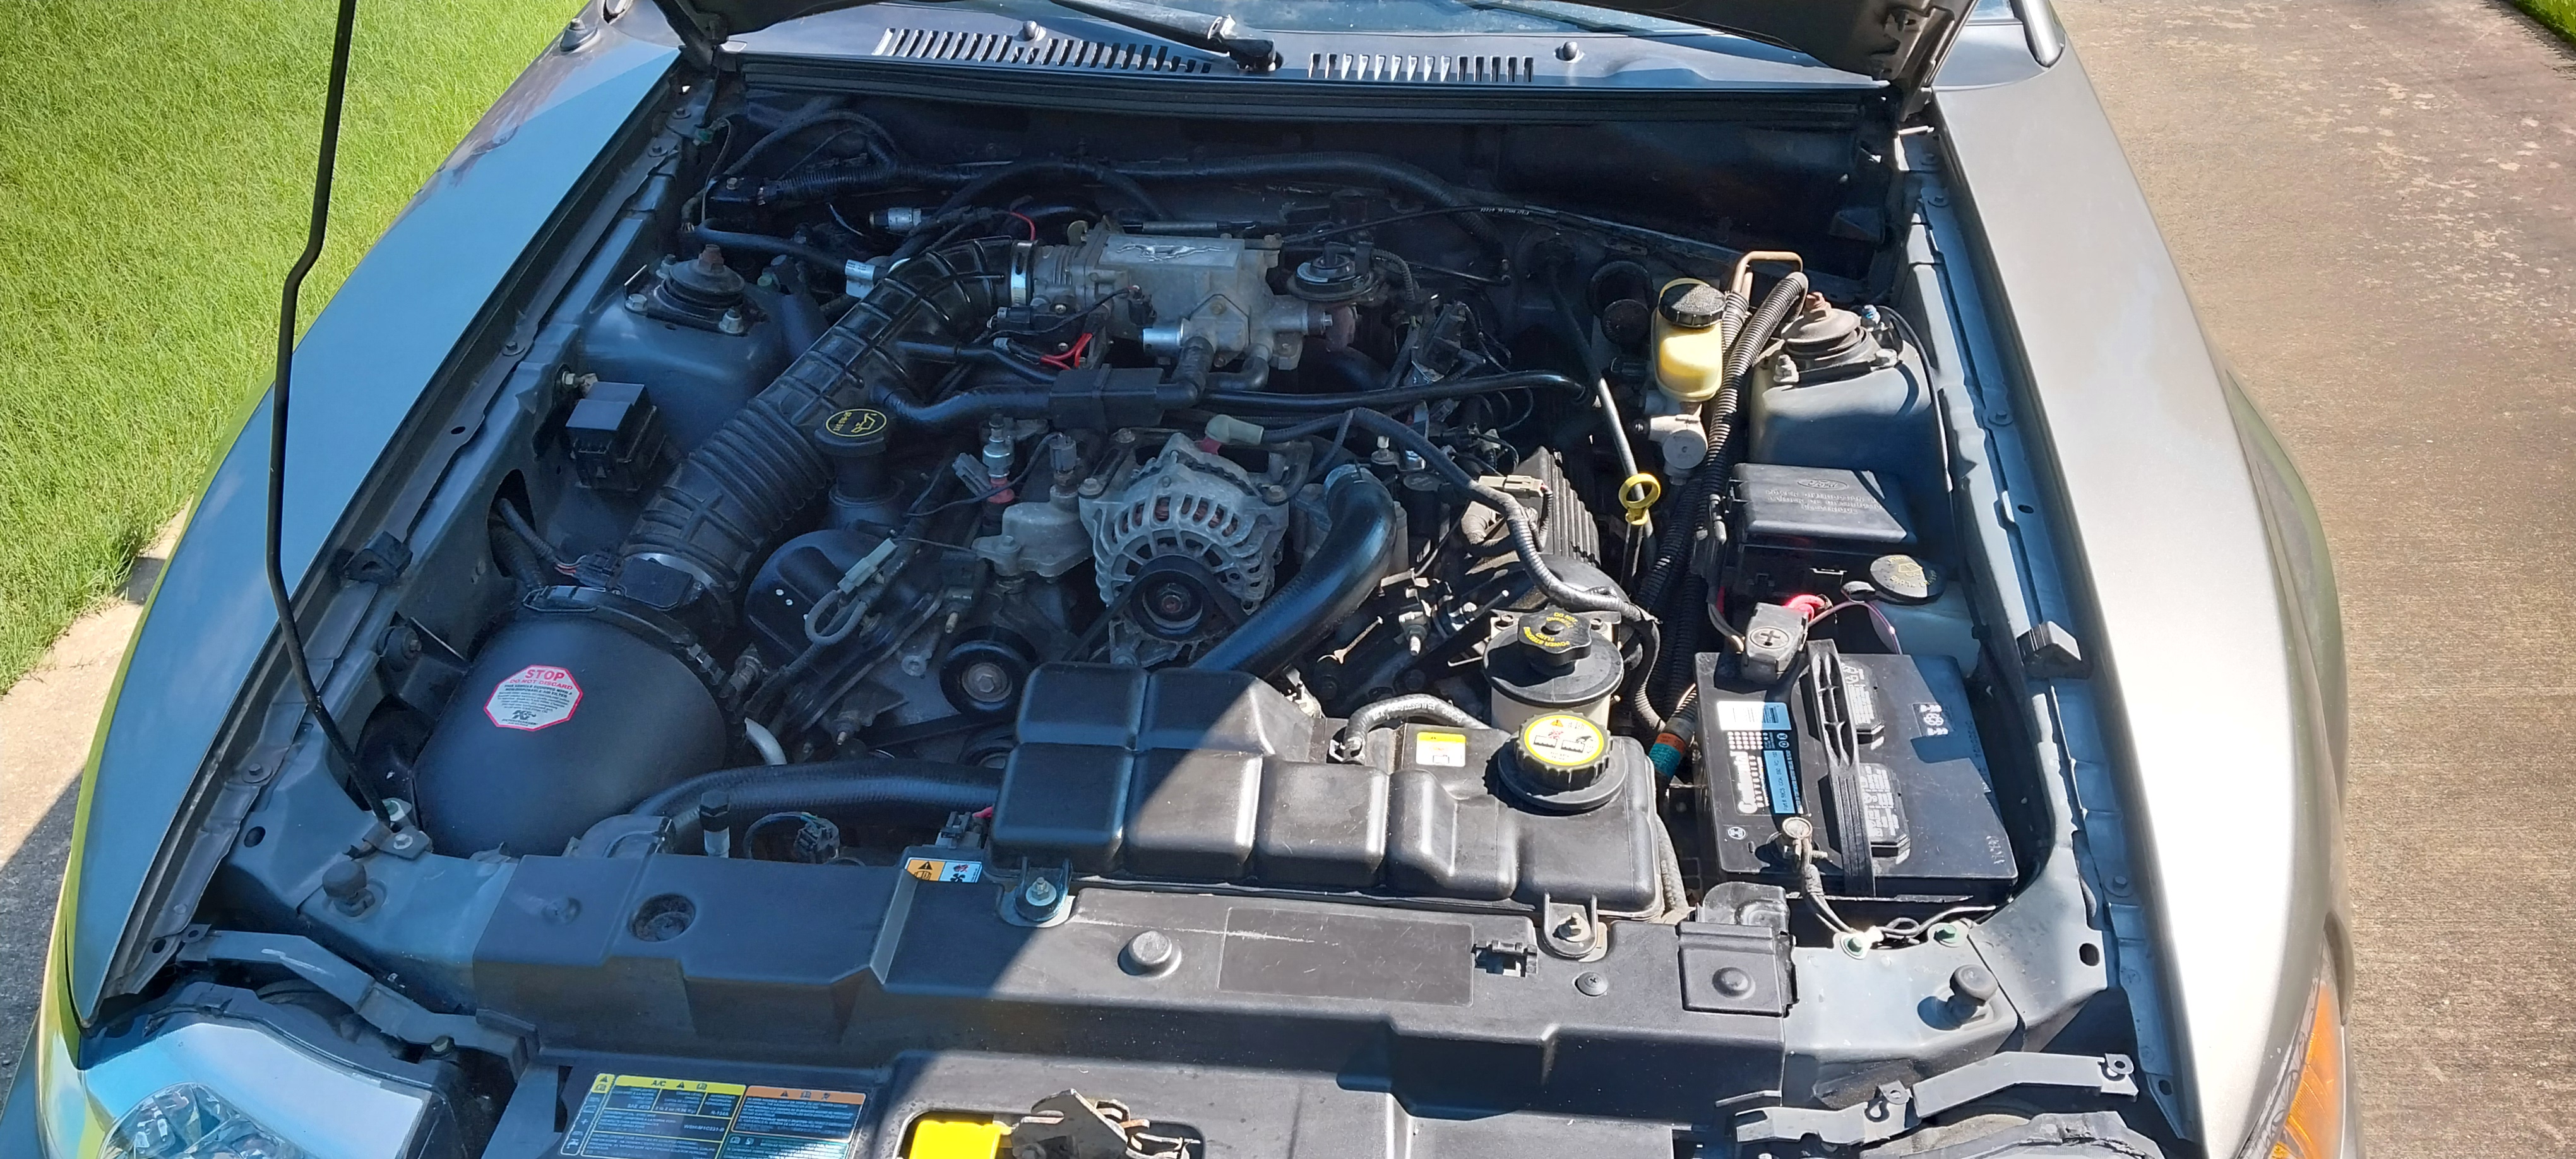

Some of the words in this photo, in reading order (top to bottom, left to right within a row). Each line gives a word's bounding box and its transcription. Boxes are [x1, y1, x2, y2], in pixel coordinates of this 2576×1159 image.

[1808, 480, 1837, 489] Ford
[1523, 626, 1544, 645] STEERING
[525, 669, 565, 681] STOP
[539, 681, 573, 690] DISCARD
